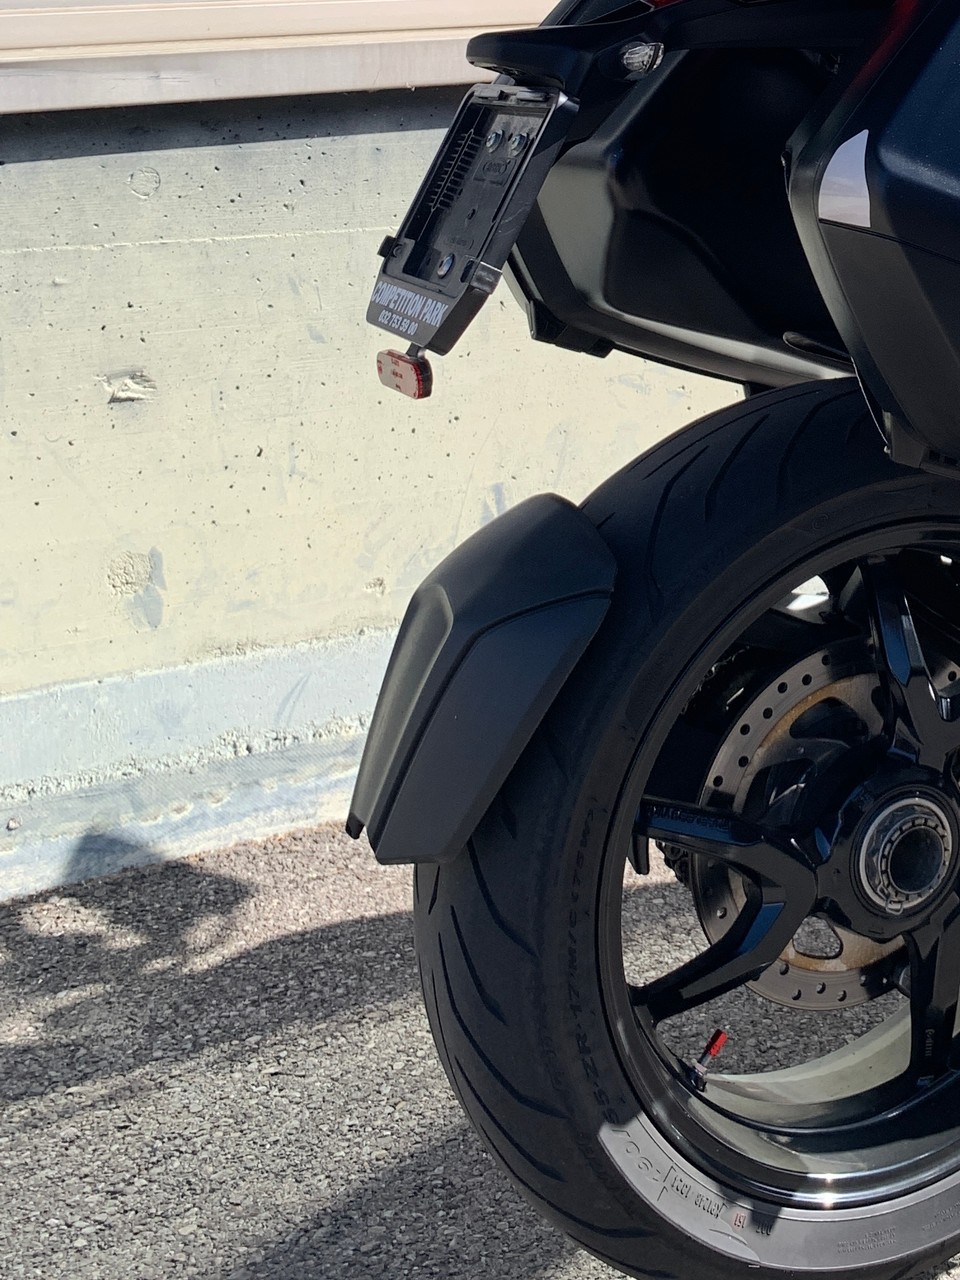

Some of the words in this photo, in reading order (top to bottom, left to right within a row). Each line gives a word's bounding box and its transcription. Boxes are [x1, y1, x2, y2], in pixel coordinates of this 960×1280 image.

[371, 281, 427, 318] COMPETITION
[419, 299, 449, 327] PARK
[378, 310, 392, 324] 032
[388, 314, 402, 329] 753
